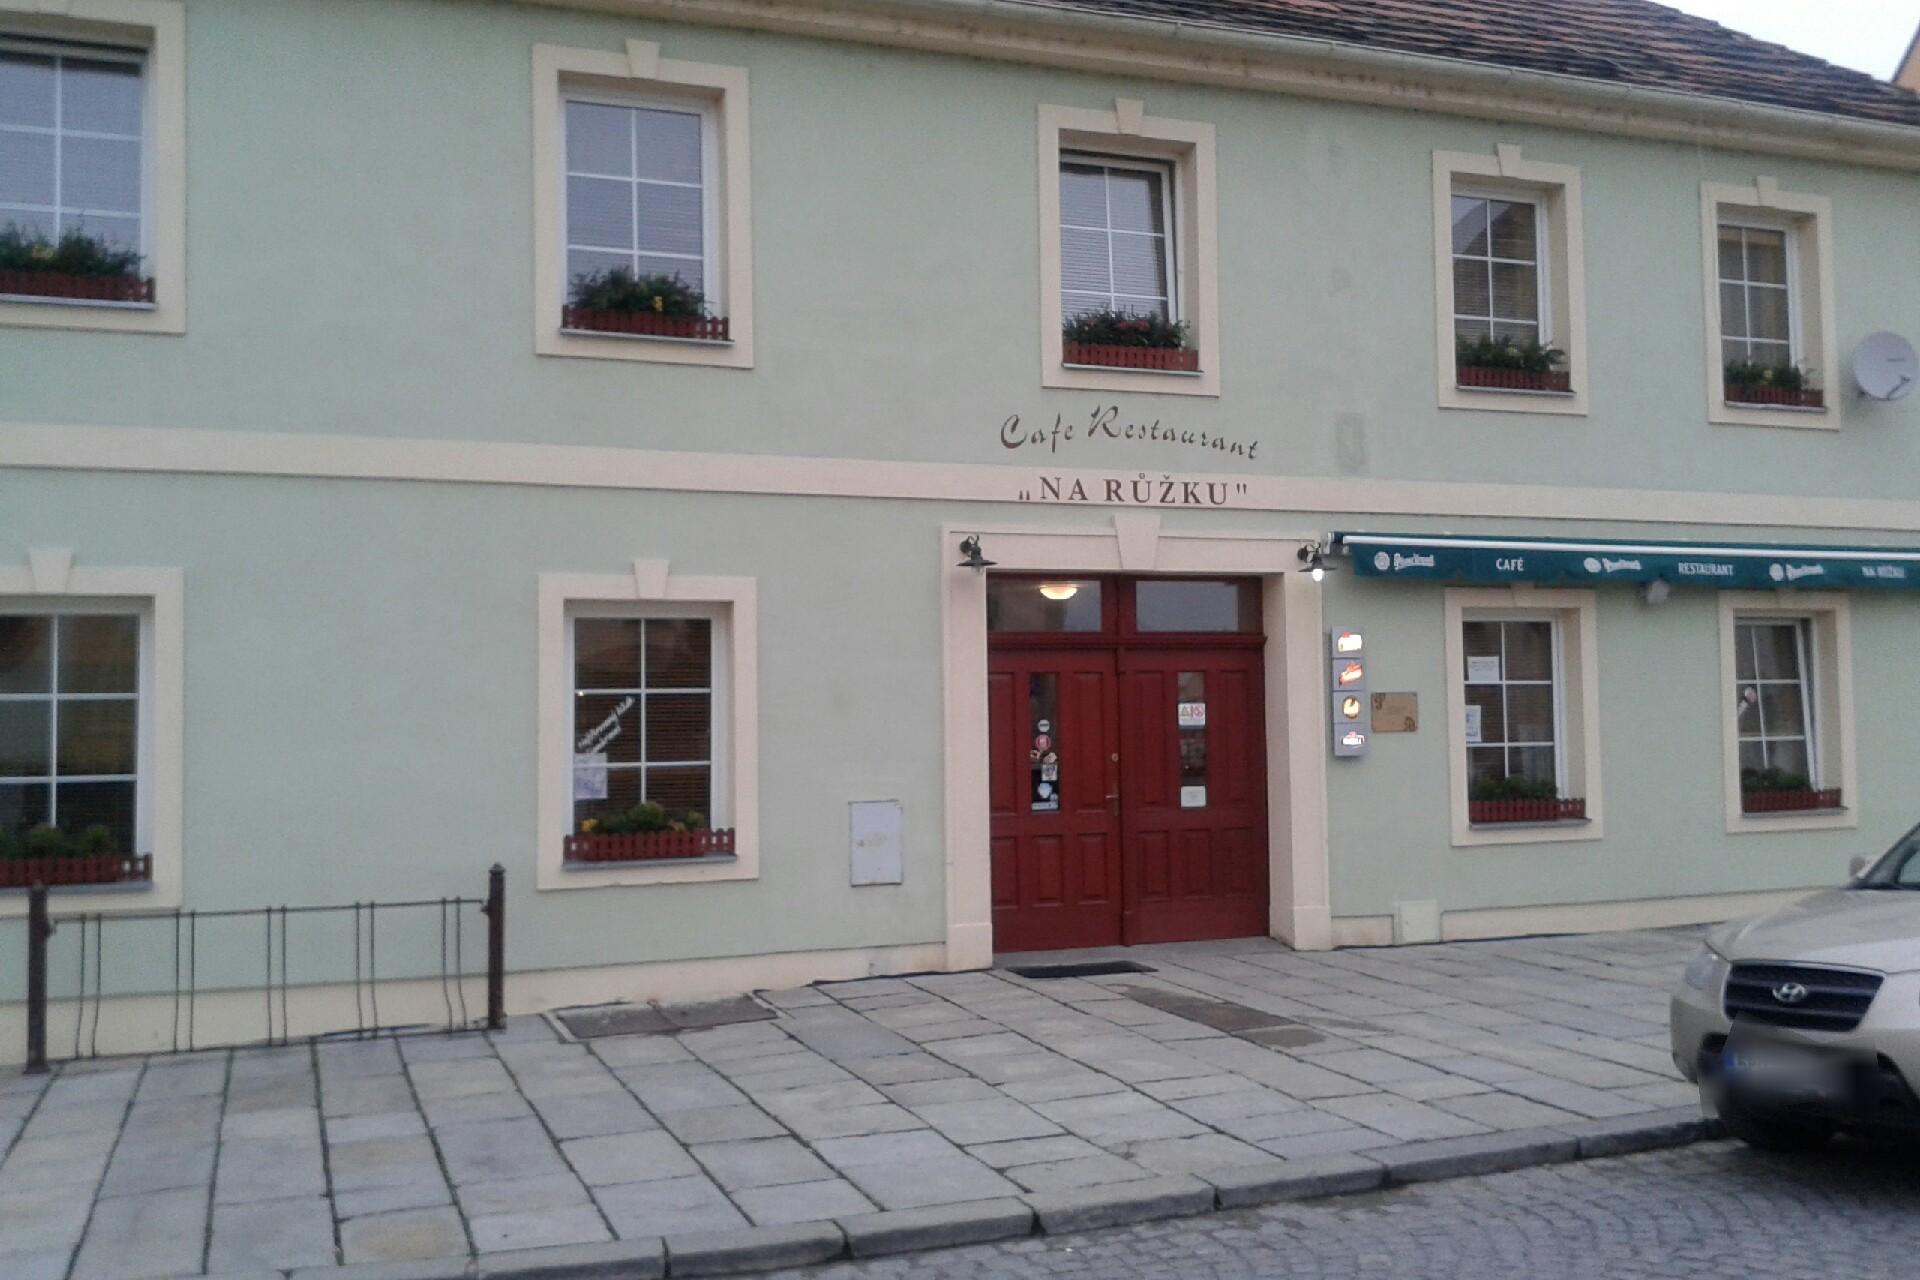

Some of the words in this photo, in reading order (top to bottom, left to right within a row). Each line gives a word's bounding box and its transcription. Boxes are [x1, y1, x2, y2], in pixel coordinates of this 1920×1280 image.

[1001, 414, 1075, 453] Cafe
[1088, 405, 1258, 459] Restaurant
[1495, 557, 1525, 571] CAFÉ
[1678, 562, 1733, 576] RESTAURANT
